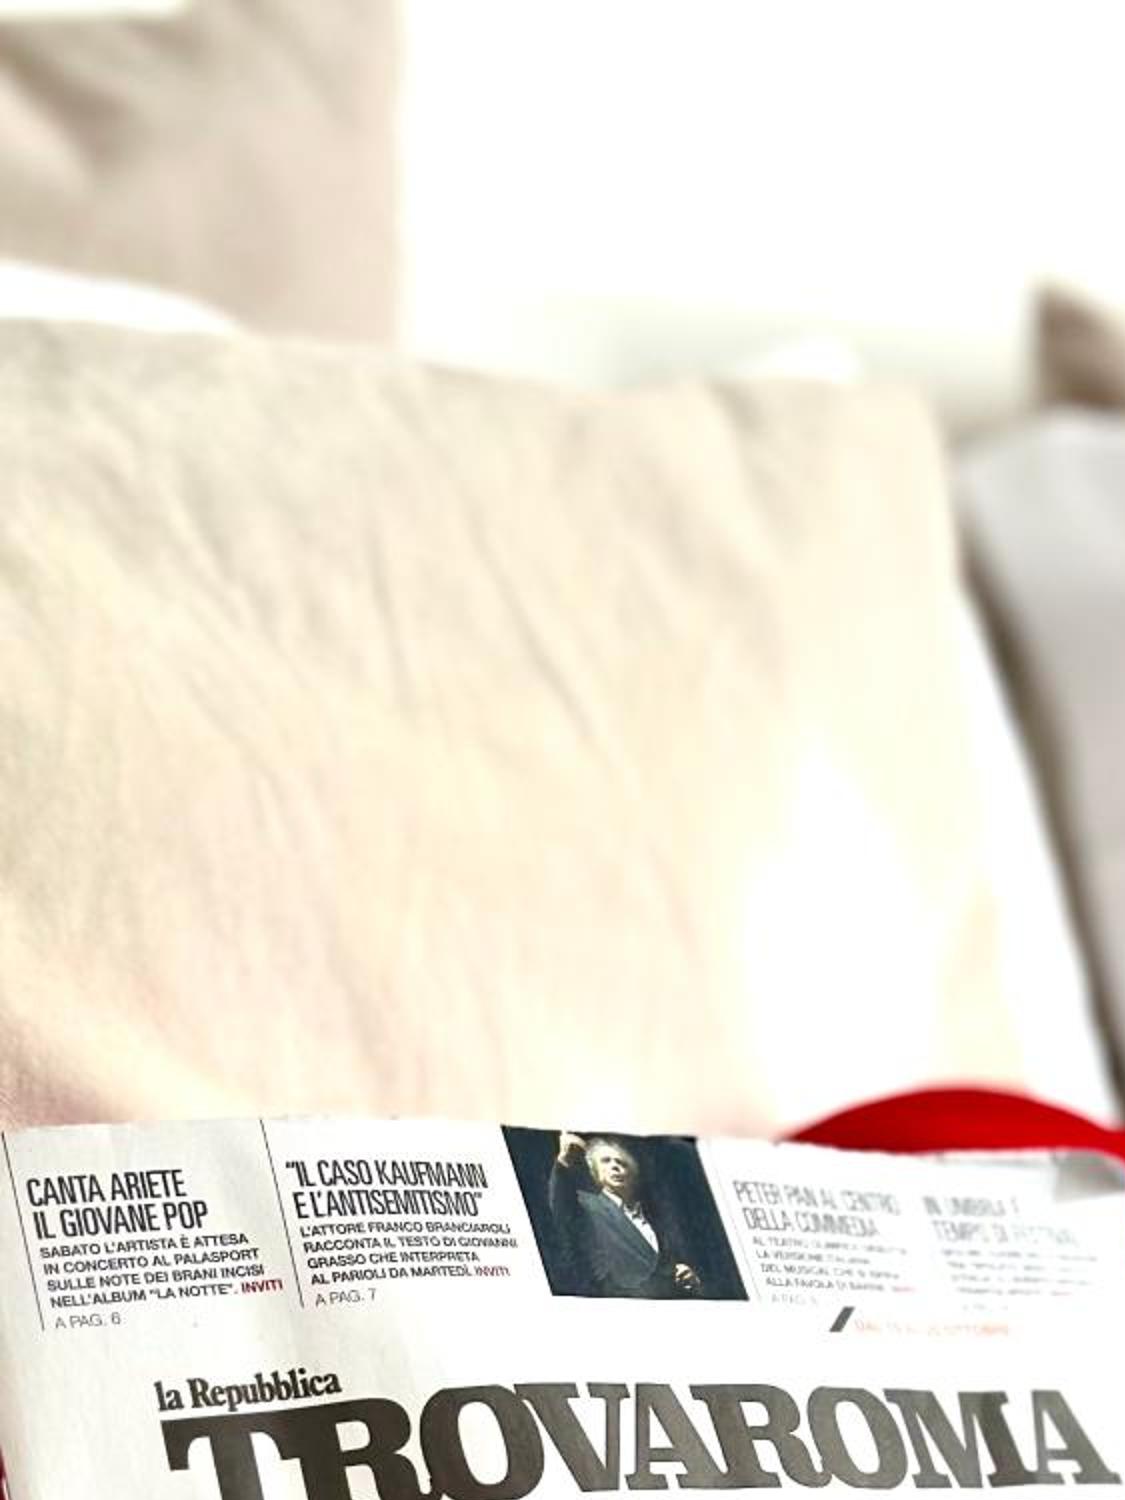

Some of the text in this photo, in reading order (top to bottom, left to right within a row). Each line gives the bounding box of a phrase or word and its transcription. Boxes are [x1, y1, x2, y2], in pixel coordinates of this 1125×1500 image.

[286, 1159, 489, 1189] "IL CASO KAUFMANN
[26, 1169, 188, 1207] CANTA ARIETE
[732, 1179, 783, 1205] PETER
[784, 1184, 819, 1208] PAN
[293, 1189, 482, 1219] E L'ANTISEMITISMO"
[33, 1200, 208, 1240] IL GIOVANE POP
[300, 1220, 511, 1238] L'ATTORE FRANCO BRANCIAROLI
[742, 1206, 881, 1238] DELLA COMMEDIA
[40, 1233, 249, 1259] SABATO L'ARTISTA È ATTESA
[303, 1235, 518, 1253] RACCONTA IL TESTO DI GIOVANNI
[43, 1248, 259, 1275] IN CONCERTO AL PALASPORT
[307, 1251, 480, 1269] GRASSO CHE INTERPRETA
[47, 1264, 265, 1292] SULLE NOTE DEI BRANI INCISI
[310, 1273, 329, 1286] AL
[332, 1268, 387, 1284] PARIOLI
[390, 1268, 408, 1279] DA
[474, 1265, 511, 1277] INVITI
[766, 1277, 791, 1288] ALLA
[50, 1290, 147, 1309] NELL'ALBUM
[150, 1286, 176, 1300] "LA
[241, 1279, 283, 1295] INVITI
[315, 1288, 377, 1307] A PAG. 7
[55, 1312, 121, 1330] A PAG. 6
[154, 1366, 342, 1413] la Repubblica
